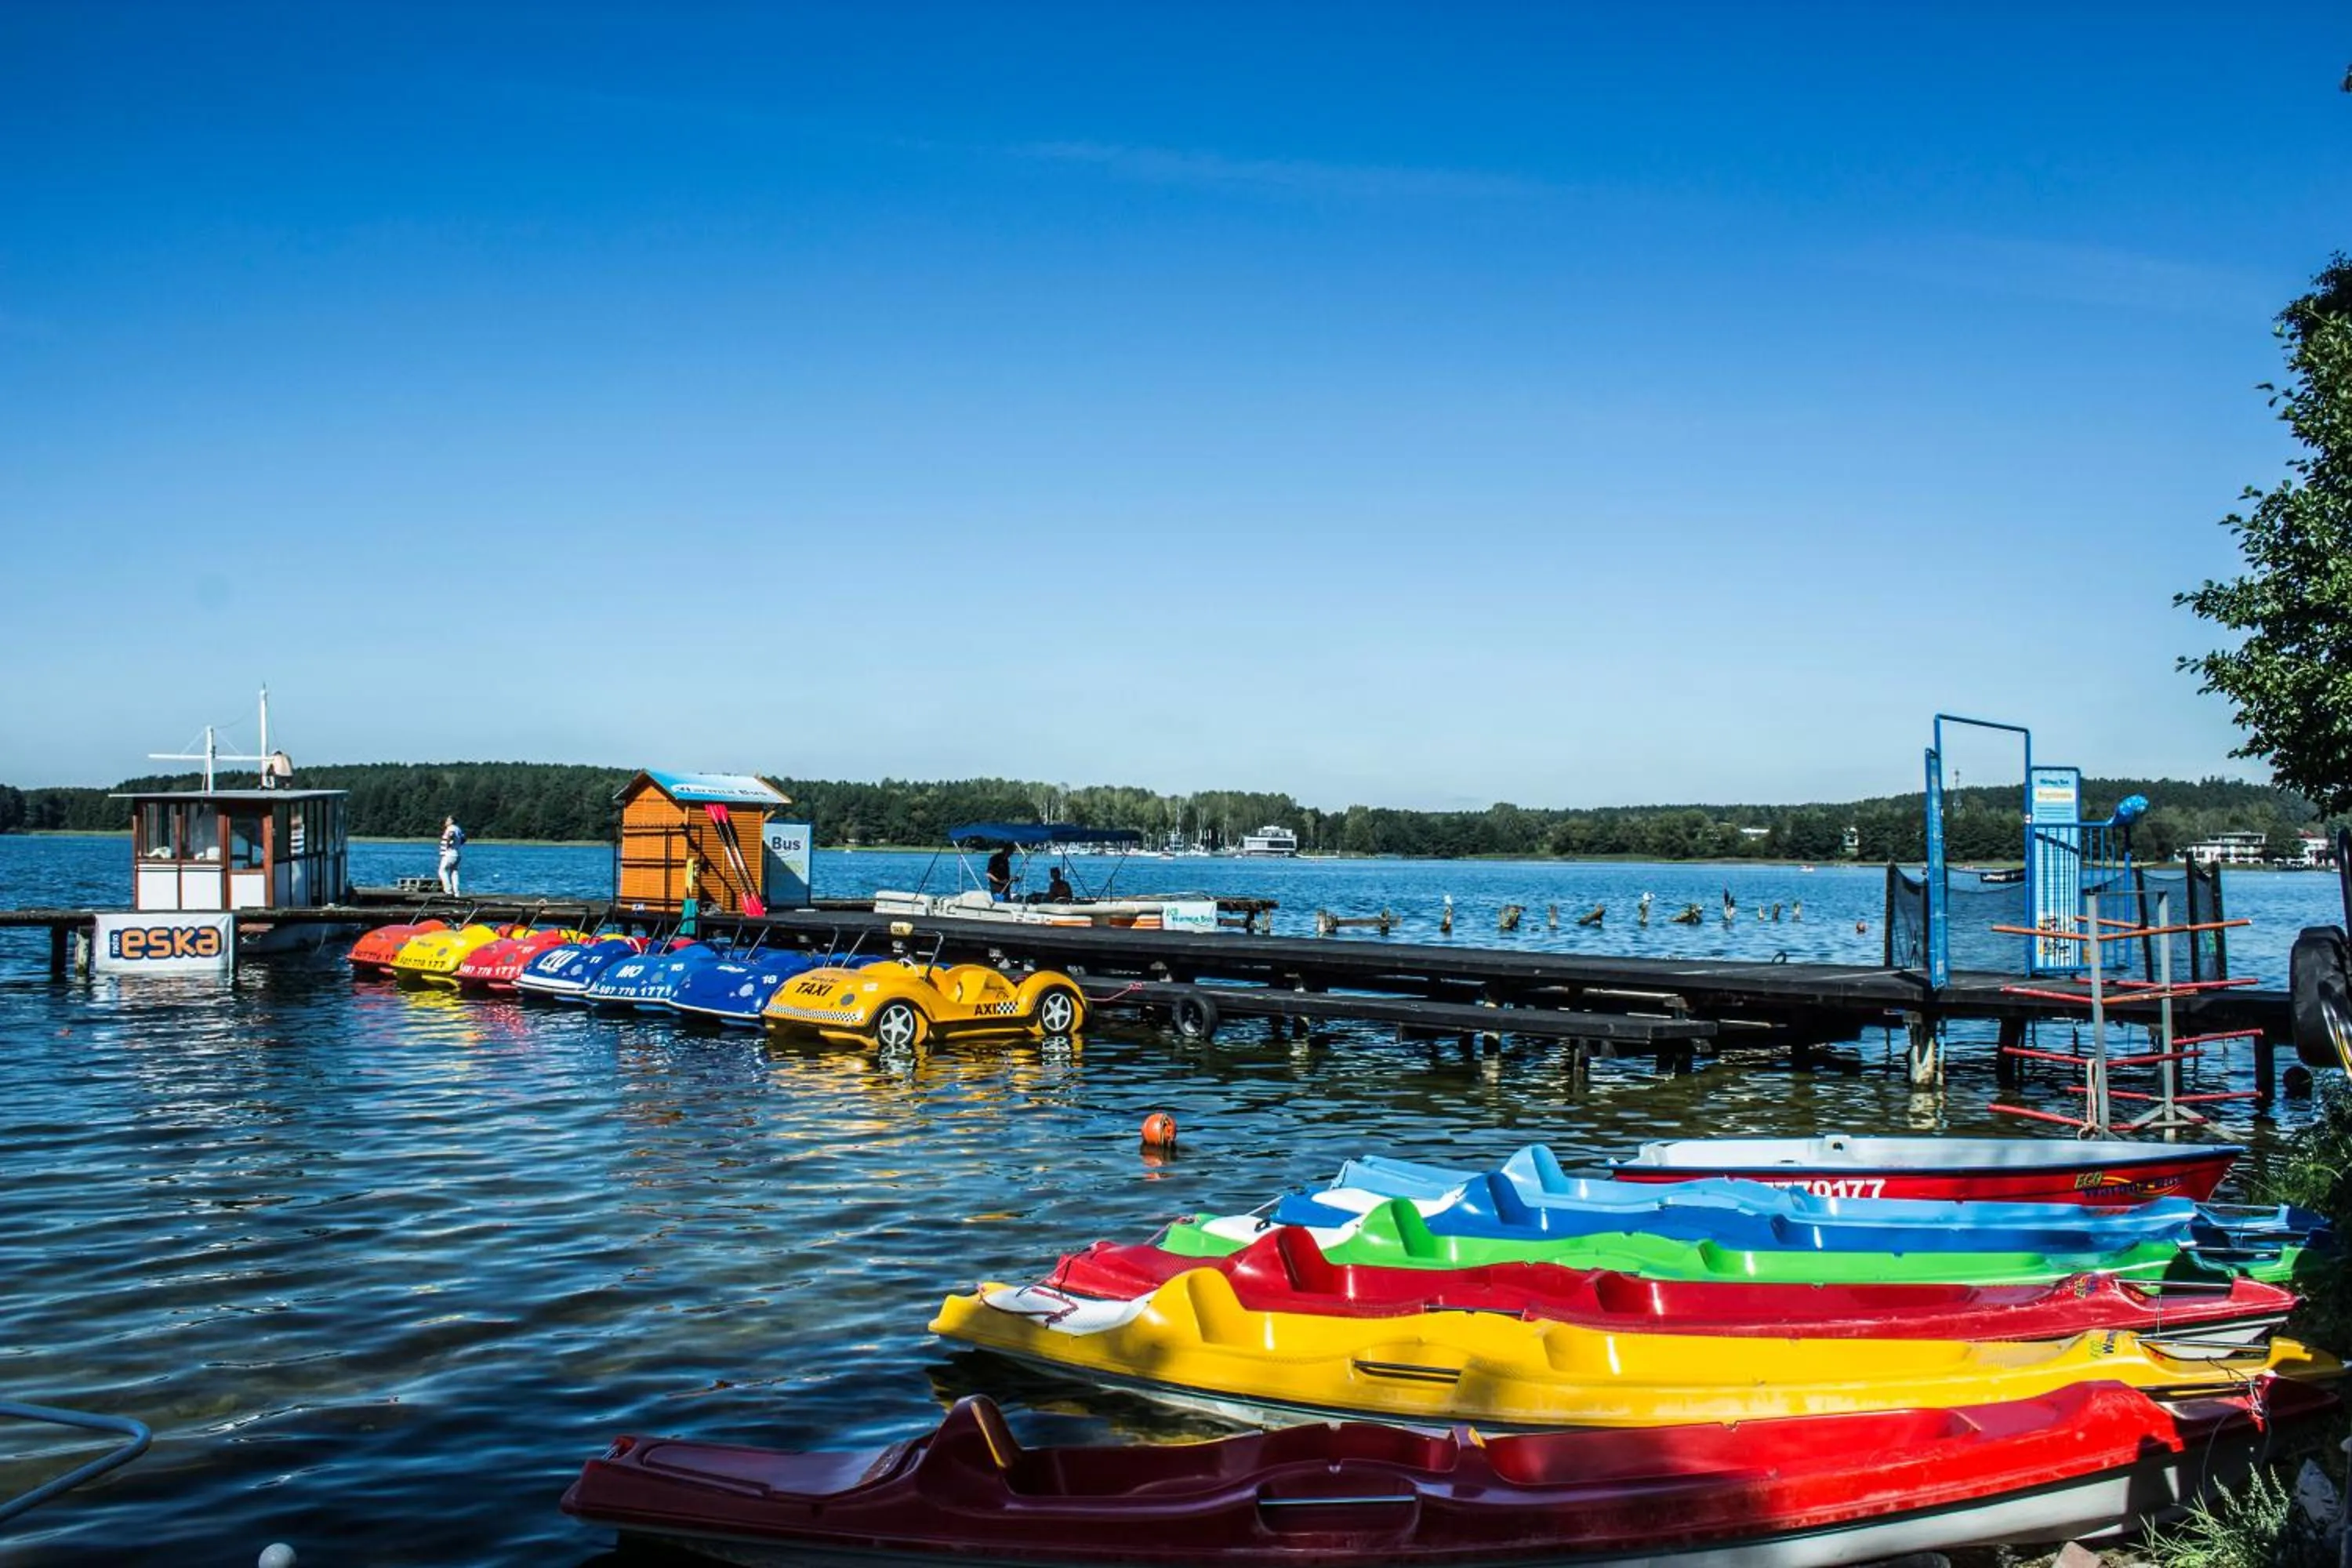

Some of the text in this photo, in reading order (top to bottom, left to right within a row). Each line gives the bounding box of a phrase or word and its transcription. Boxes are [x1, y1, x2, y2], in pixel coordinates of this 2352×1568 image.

[771, 836, 801, 851] Bus
[121, 927, 220, 959] eska
[796, 982, 833, 996] TAXI
[1761, 1179, 1886, 1199] 70177
[2074, 1171, 2103, 1190] ECO
